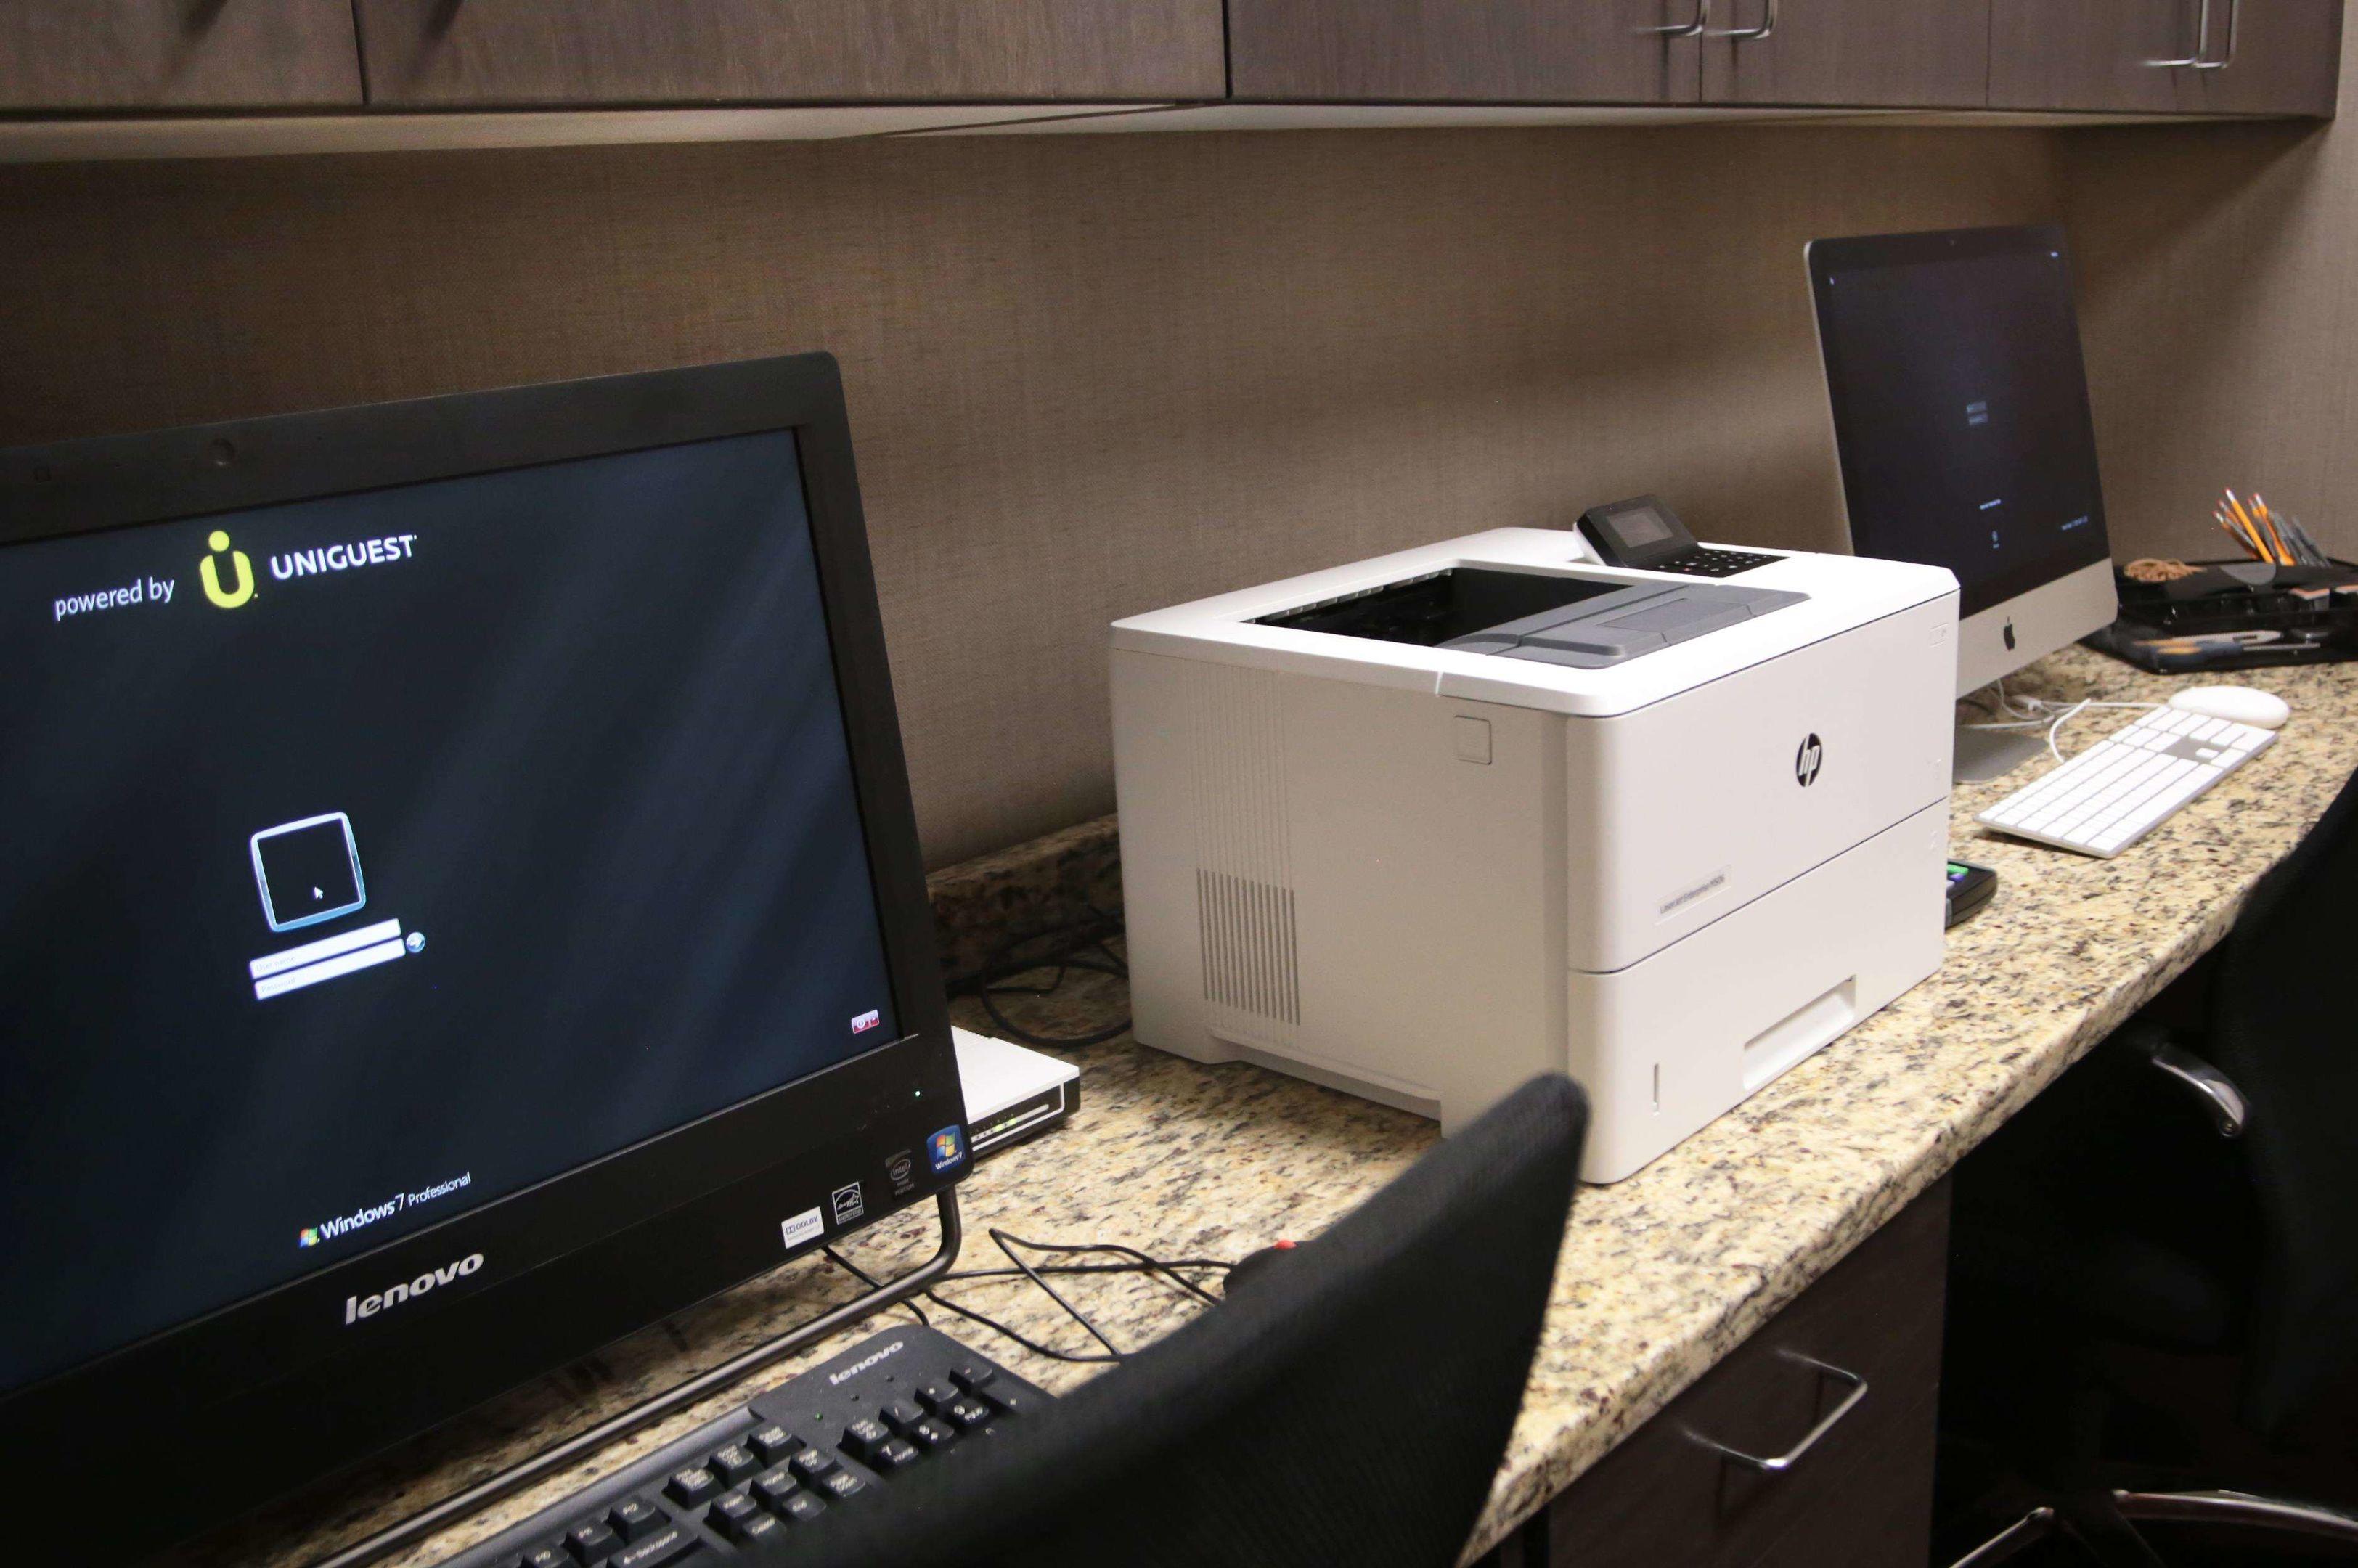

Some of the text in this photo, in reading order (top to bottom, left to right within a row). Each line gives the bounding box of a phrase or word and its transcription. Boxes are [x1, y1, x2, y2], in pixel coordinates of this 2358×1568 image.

[270, 534, 416, 580] UNIGUEST
[54, 576, 175, 621] powered by
[320, 1171, 472, 1241] Windows 7 Professional
[346, 1253, 484, 1325] lenovo
[829, 1341, 904, 1385] lenovo
